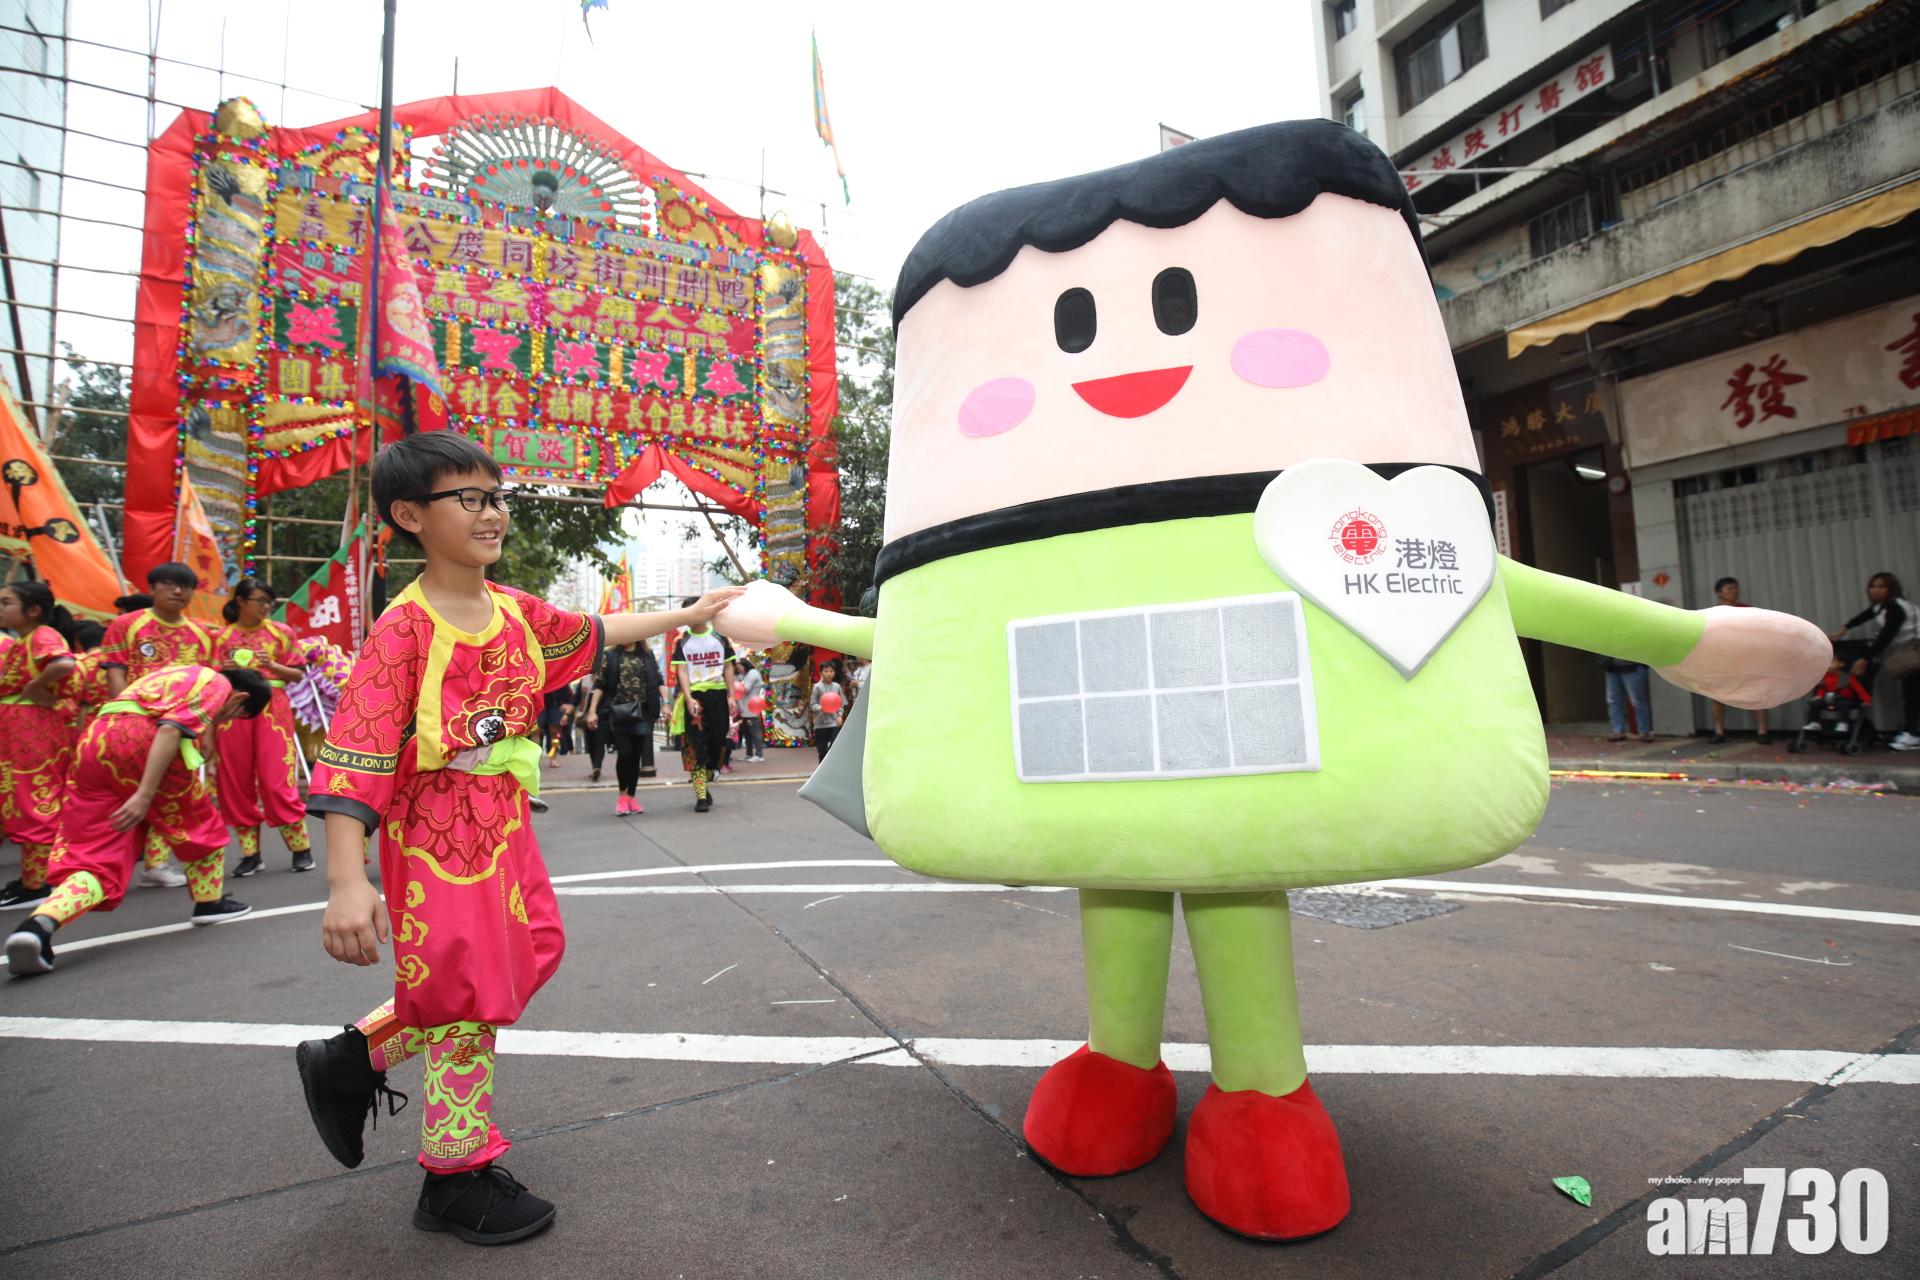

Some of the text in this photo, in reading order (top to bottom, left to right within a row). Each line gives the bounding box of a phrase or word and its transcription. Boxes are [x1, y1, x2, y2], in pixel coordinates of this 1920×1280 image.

[1395, 538, 1460, 571] 港燈
[1344, 573, 1464, 595] HK Electric
[351, 755, 382, 769] LION
